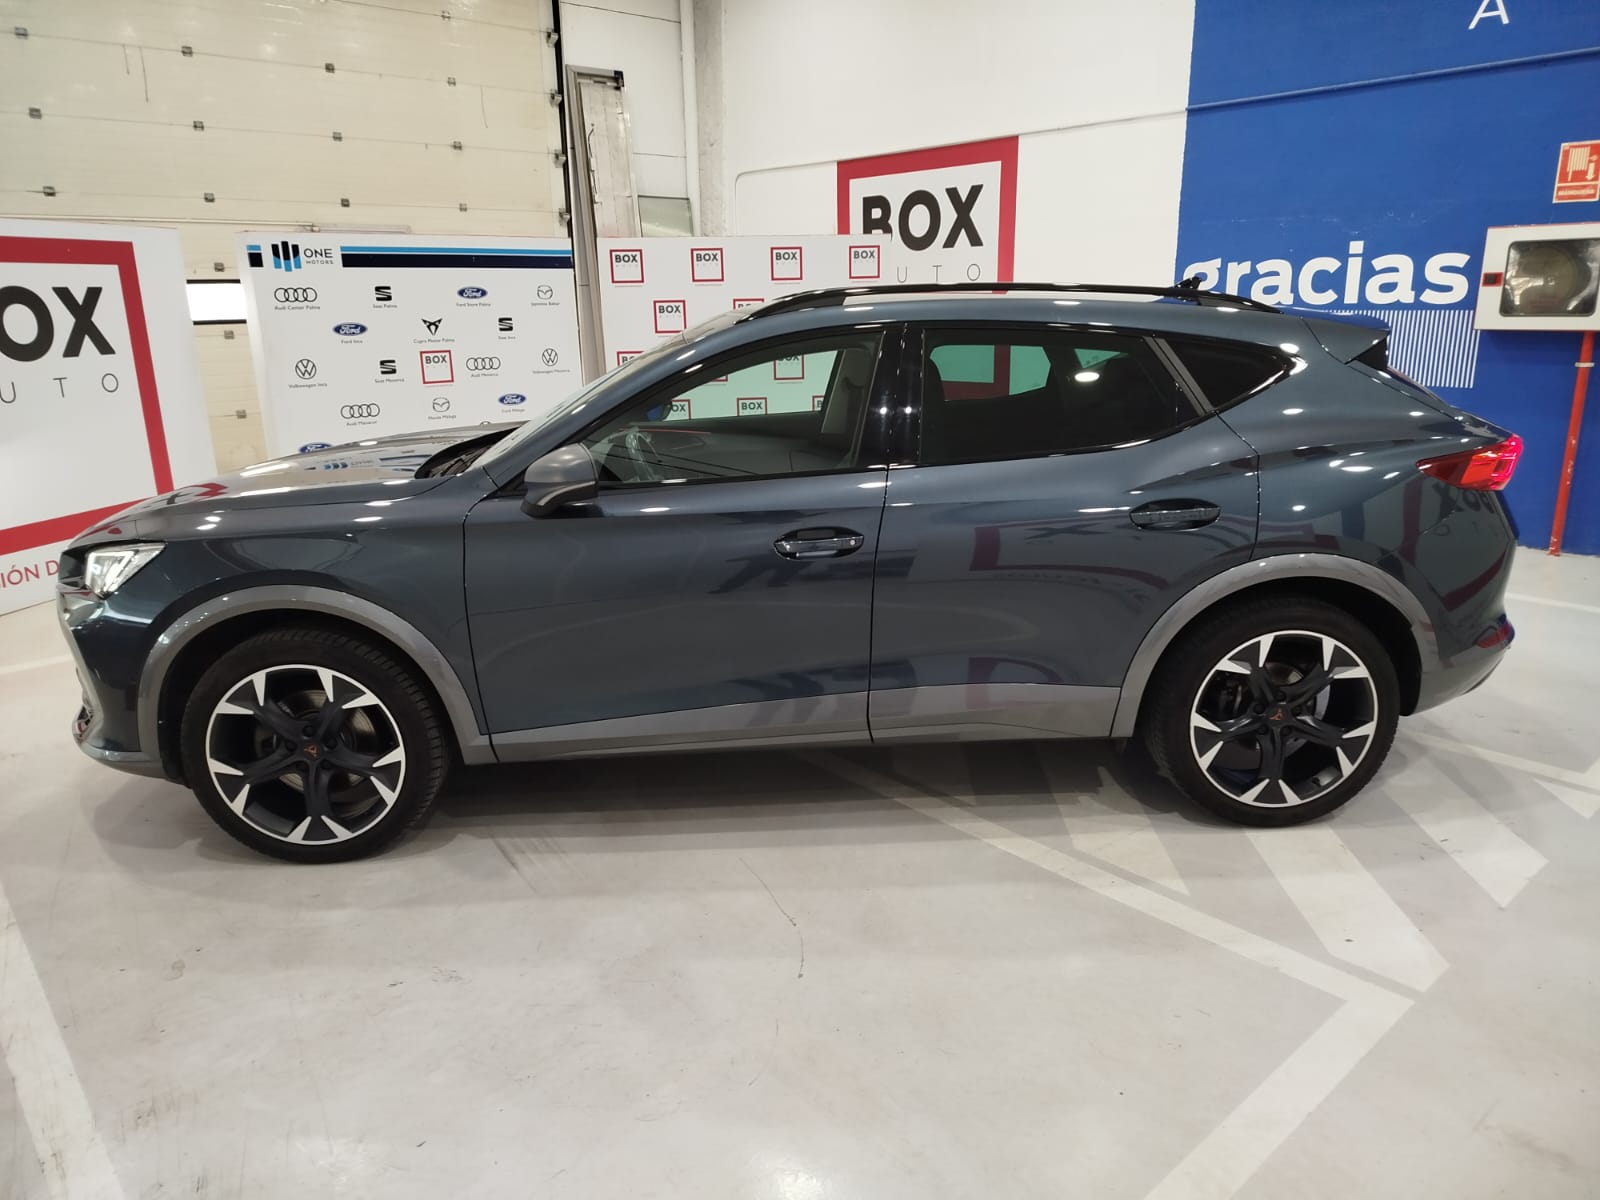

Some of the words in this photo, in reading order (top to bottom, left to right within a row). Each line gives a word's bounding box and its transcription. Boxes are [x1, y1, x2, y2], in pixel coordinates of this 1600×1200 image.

[862, 184, 984, 251] BOX
[303, 248, 334, 259] ONE
[614, 253, 638, 263] BOX
[695, 252, 719, 262] BOX
[775, 251, 798, 261] BOX
[852, 250, 876, 260] BOX
[897, 263, 981, 284] UTO
[1182, 241, 1471, 306] gracias
[658, 304, 681, 314] BOX
[425, 354, 448, 364] BOX
[672, 403, 686, 413] OX
[741, 401, 763, 410] BOX
[0, 564, 40, 588] IÓN
